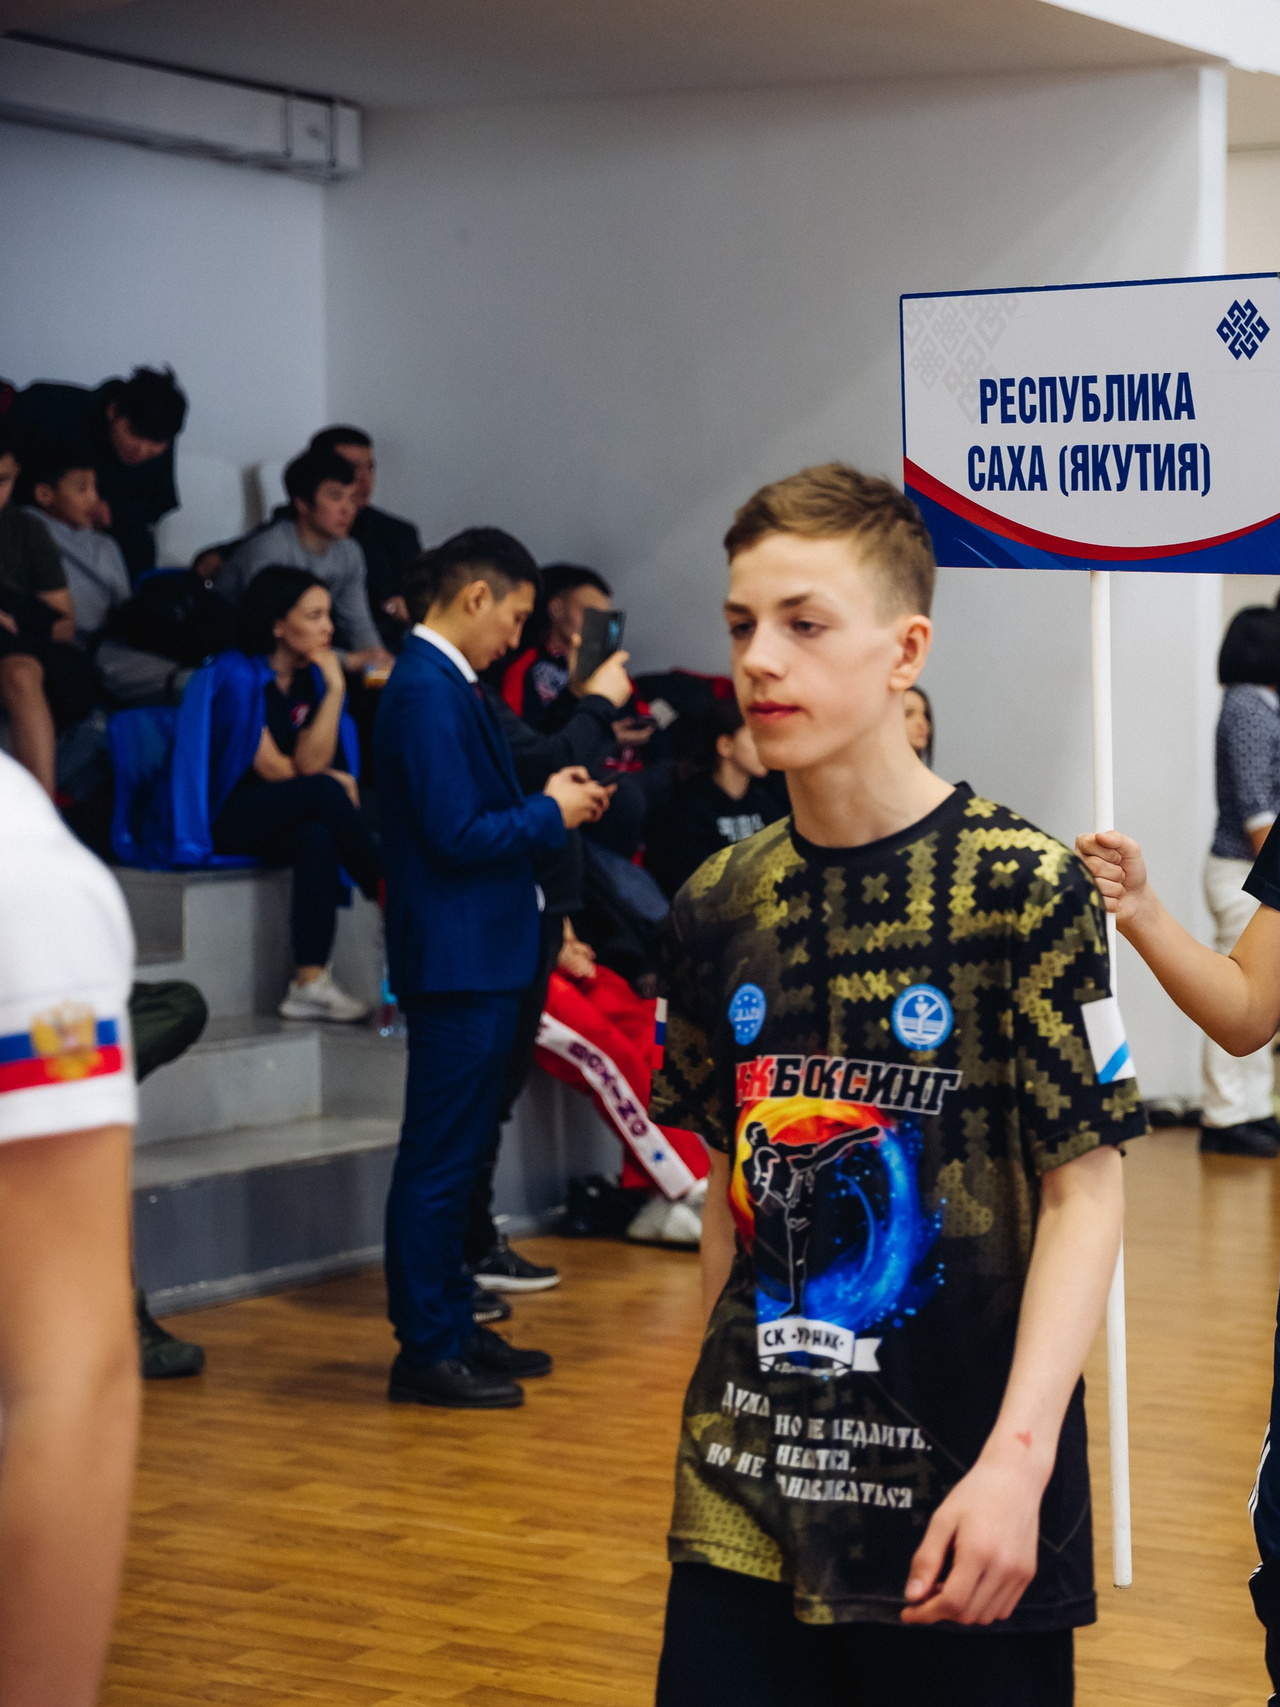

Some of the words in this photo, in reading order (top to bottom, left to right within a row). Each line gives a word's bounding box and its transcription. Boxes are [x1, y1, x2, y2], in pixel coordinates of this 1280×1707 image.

[979, 371, 1196, 424] РЕСПУБЛИКА
[967, 445, 1048, 492] САХА
[1058, 442, 1212, 497] (ЯКУТИЯ)
[763, 1328, 786, 1347] СК
[774, 1413, 803, 1436] НО
[705, 1442, 732, 1467] НО
[735, 1452, 766, 1478] НЕ
